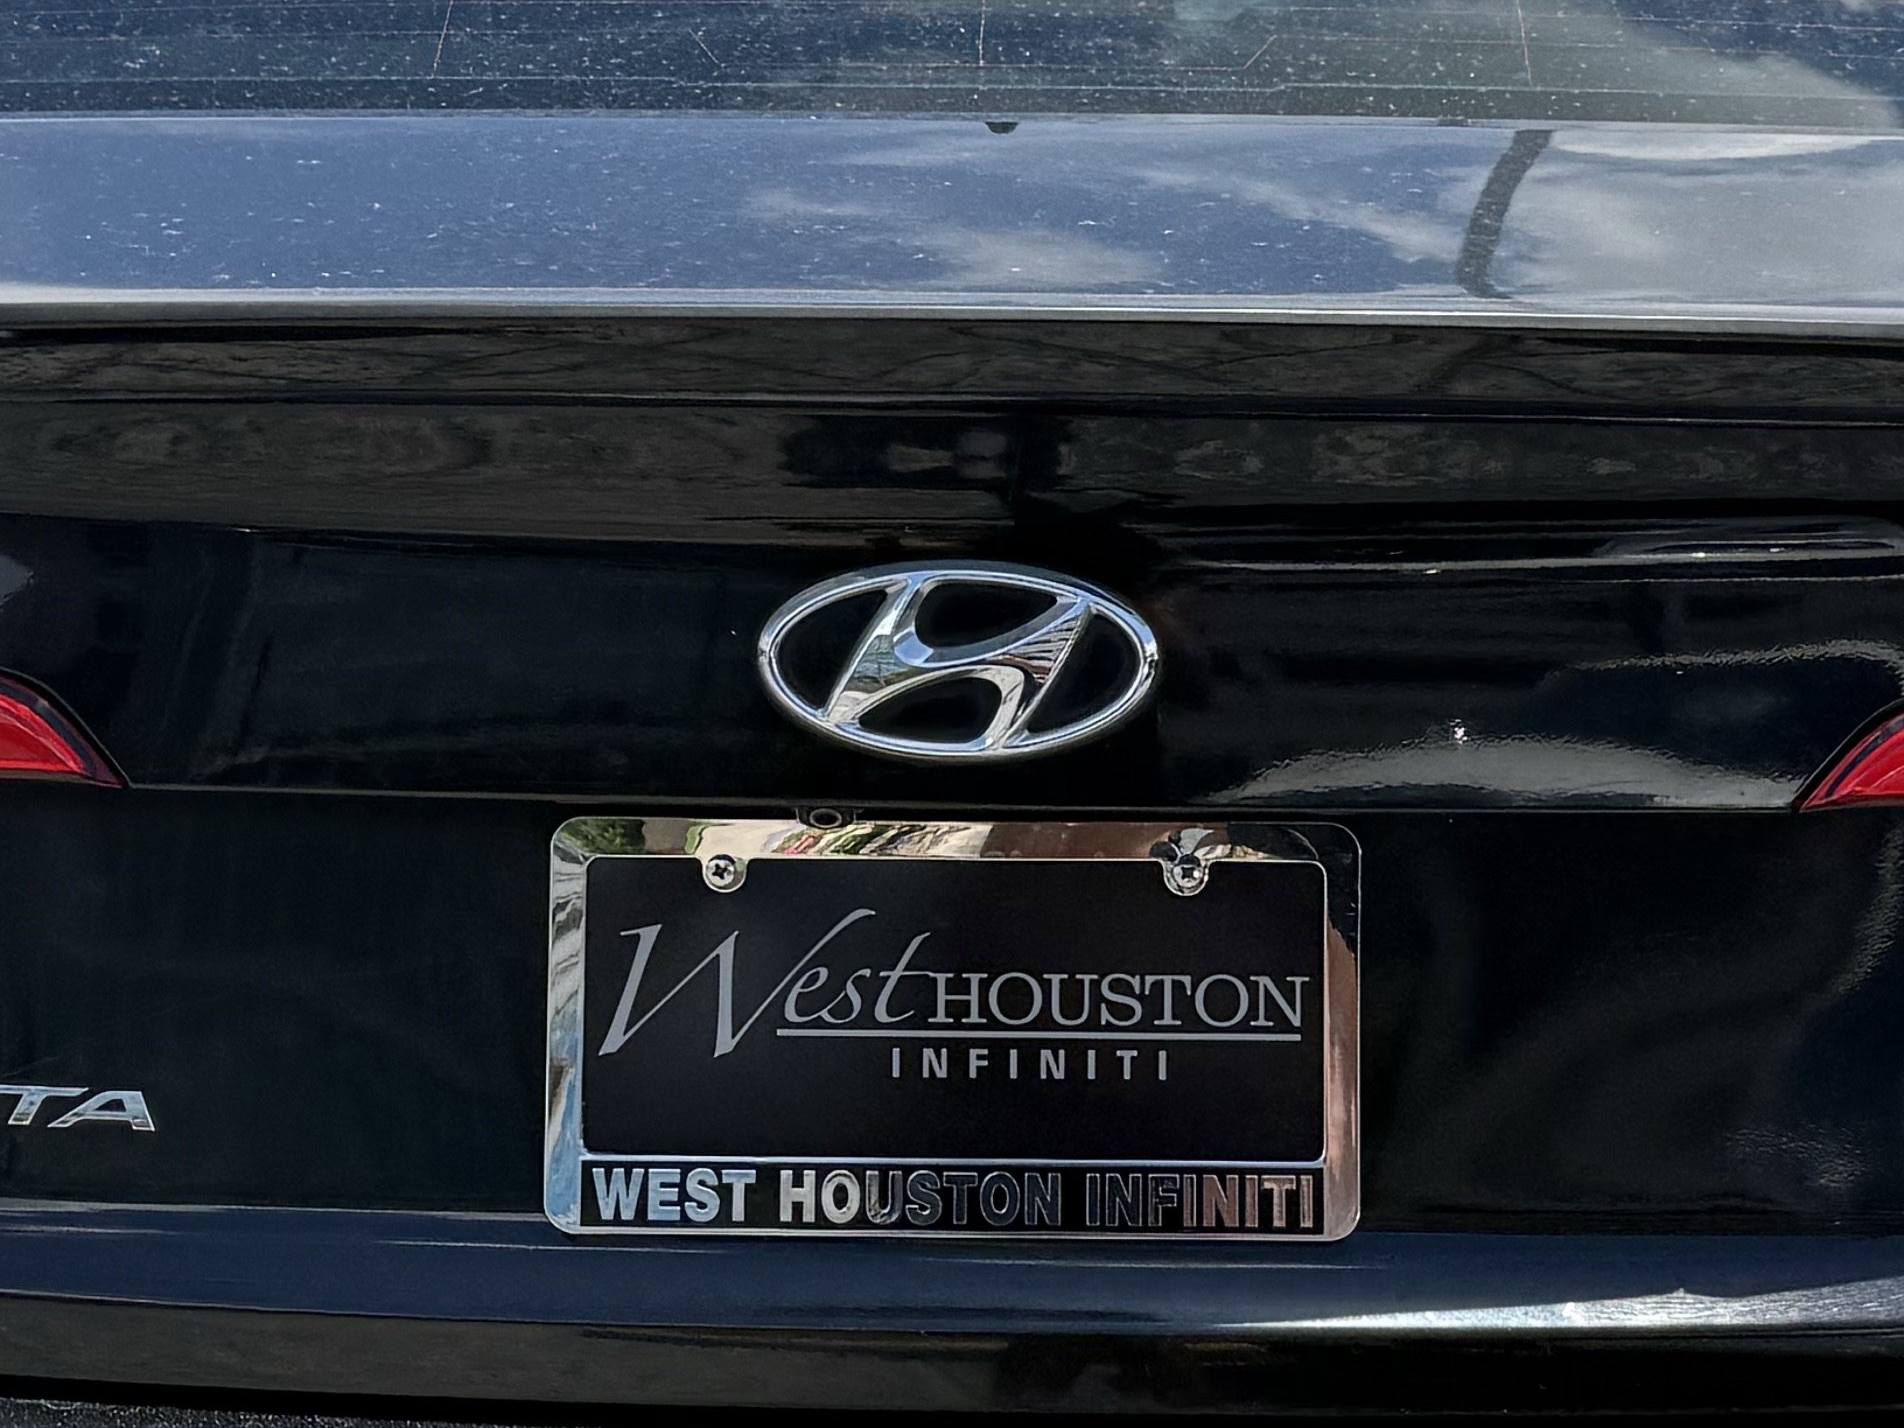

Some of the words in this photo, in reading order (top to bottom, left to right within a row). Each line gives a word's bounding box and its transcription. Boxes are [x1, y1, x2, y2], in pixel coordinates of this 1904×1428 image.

[598, 909, 932, 1057] West
[927, 972, 1310, 1028] HOUSTON
[892, 1047, 1168, 1081] INFINITI
[591, 1167, 756, 1223] WEST
[779, 1169, 1062, 1227] HOUSTON
[1086, 1173, 1315, 1230] INFINITI
